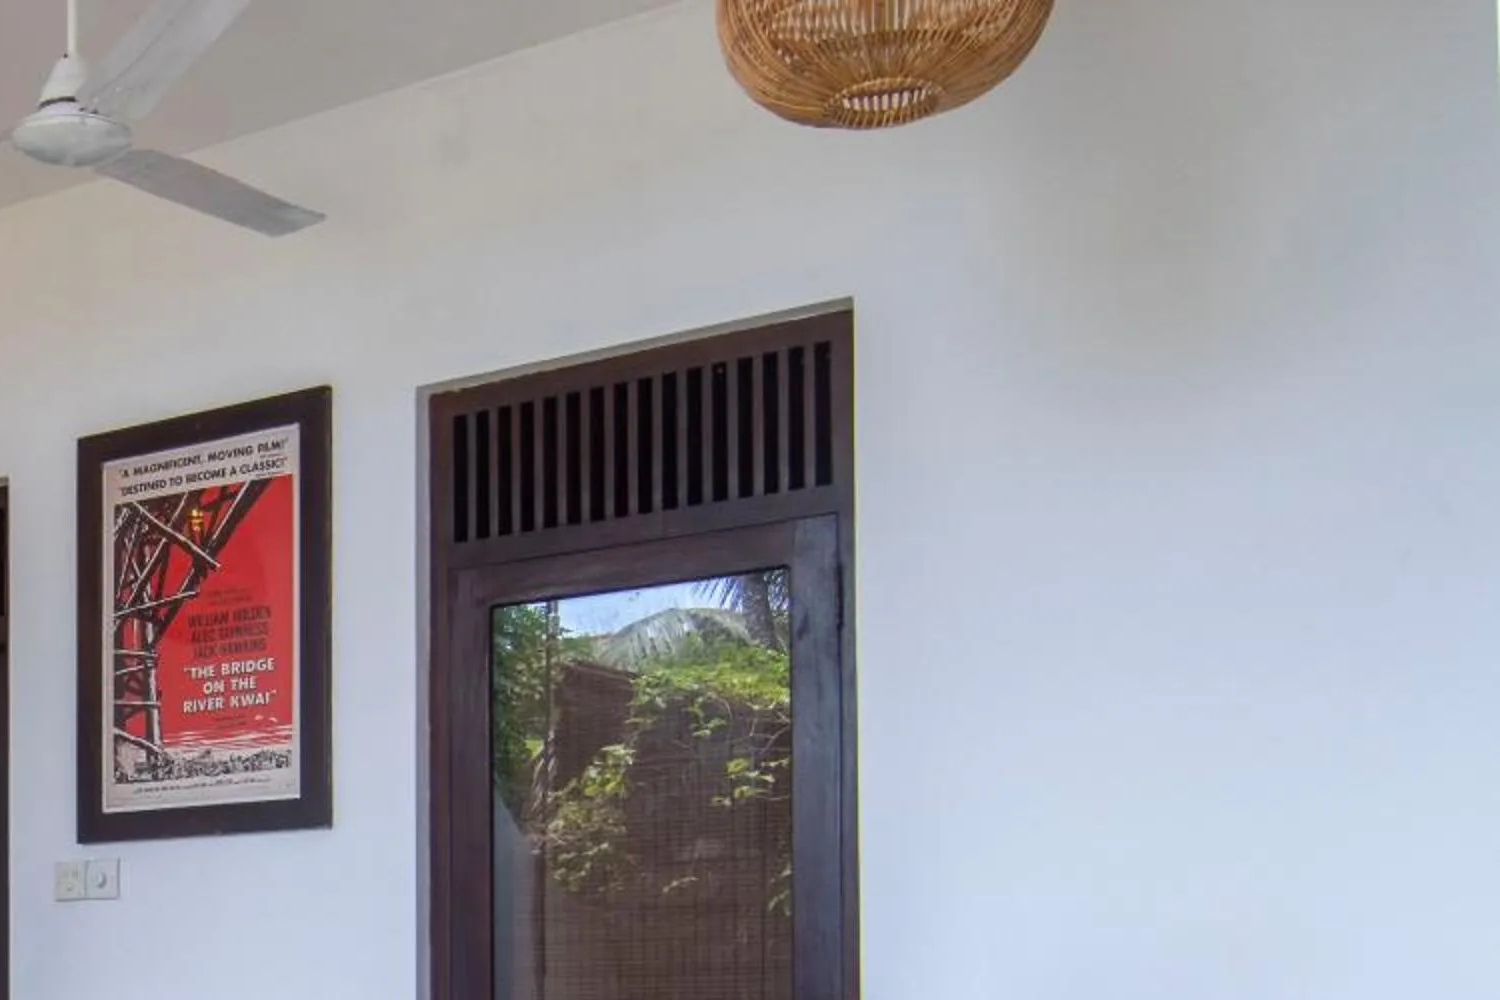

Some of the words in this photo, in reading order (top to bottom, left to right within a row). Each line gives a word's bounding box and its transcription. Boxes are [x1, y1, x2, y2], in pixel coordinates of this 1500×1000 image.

[207, 445, 253, 462] MOVING
[169, 476, 183, 487] TO
[186, 467, 227, 484] BECOME
[229, 465, 238, 475] A
[188, 609, 229, 628] WILLIAM
[232, 605, 272, 621] HOLDEN
[183, 664, 216, 679] "THE
[221, 657, 275, 676] BRIDGE
[203, 680, 225, 695] ON
[230, 675, 257, 690] THE
[183, 697, 224, 713] RIVER
